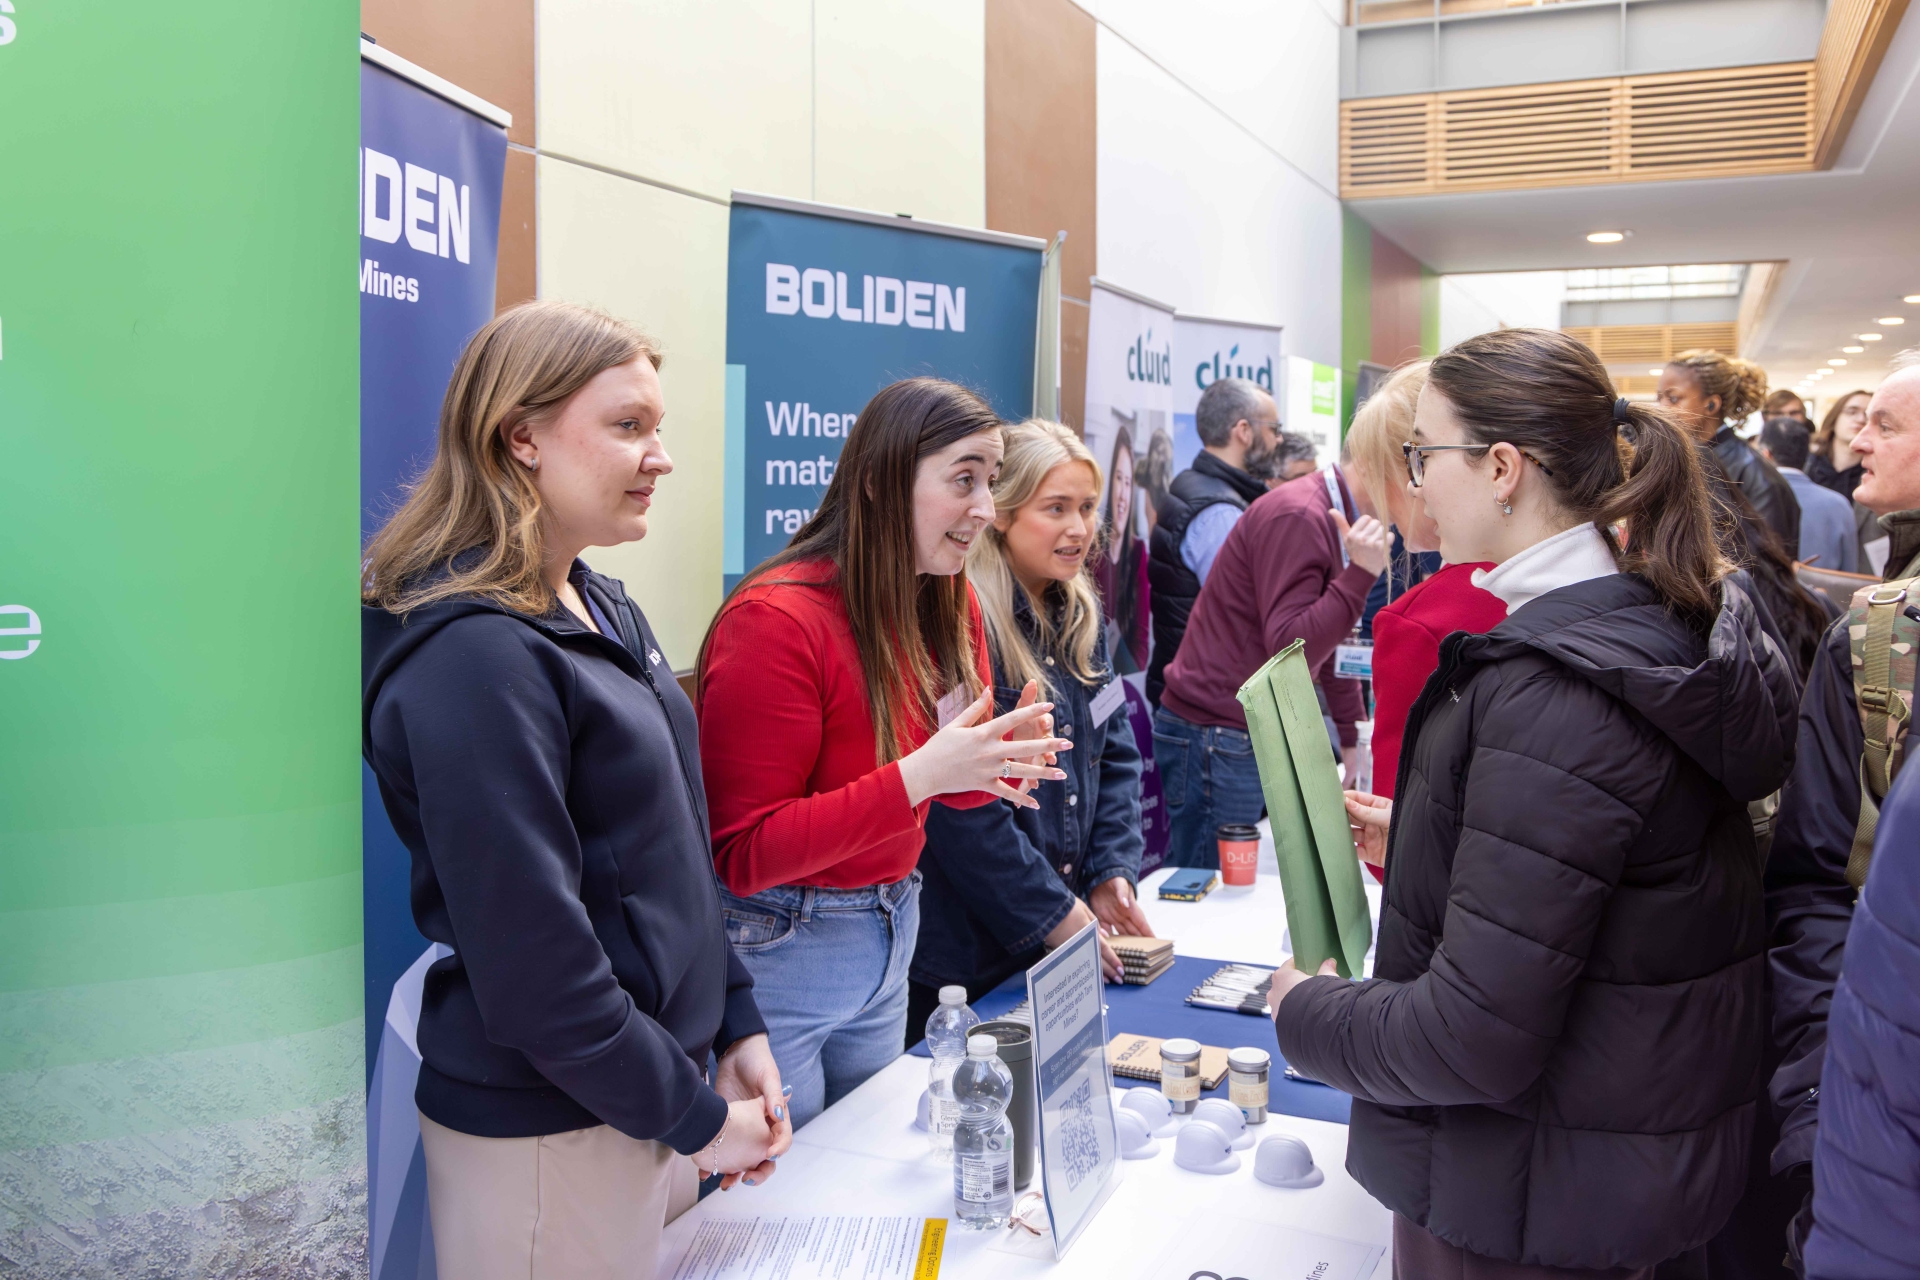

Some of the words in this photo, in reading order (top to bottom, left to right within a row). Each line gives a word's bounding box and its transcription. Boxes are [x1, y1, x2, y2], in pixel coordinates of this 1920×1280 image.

[360, 147, 470, 264] DEN
[766, 262, 966, 333] BOLIDEN
[766, 455, 839, 486] mat
[1041, 1002, 1057, 1021] career
[1056, 993, 1065, 1008] and
[1065, 969, 1095, 999] apprenticeship
[1043, 974, 1067, 1004] Interested
[1072, 959, 1091, 981] exploring
[1045, 1001, 1075, 1032] opportunities
[1074, 992, 1084, 1006] with
[1063, 1008, 1079, 1030] Mines?
[928, 1228, 942, 1256] Engineering
[925, 1257, 938, 1277] Options
